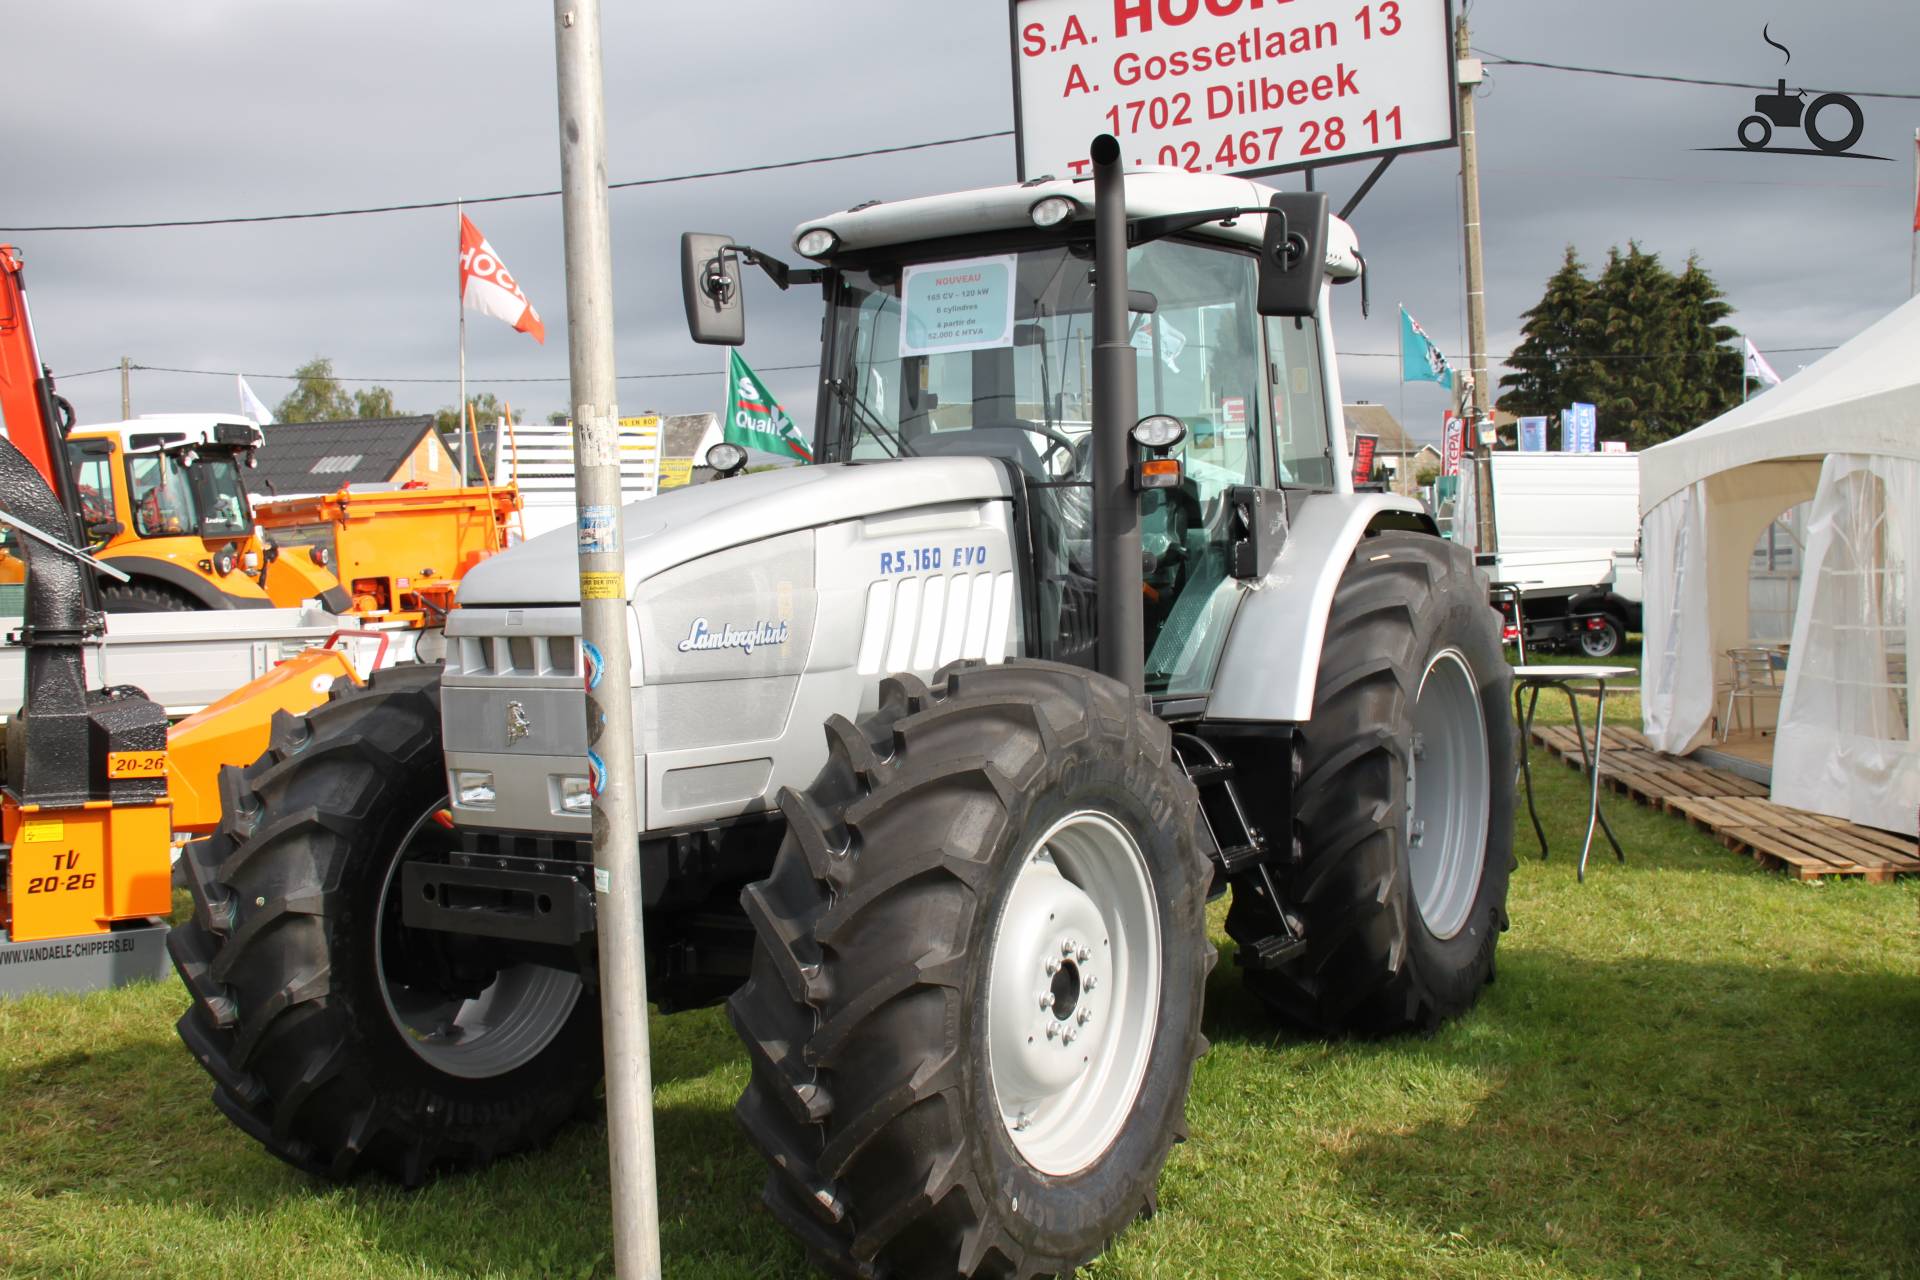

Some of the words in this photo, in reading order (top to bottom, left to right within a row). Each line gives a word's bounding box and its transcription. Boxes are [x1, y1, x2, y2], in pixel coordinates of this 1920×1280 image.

[1022, 14, 1098, 57] S.A.
[1063, 64, 1099, 97] A.
[1113, 20, 1337, 86] Gossetlaan
[1354, 1, 1402, 40] 13
[1105, 92, 1193, 137] 1702
[1206, 63, 1360, 120] Dilbeek
[1298, 116, 1346, 156] 28
[1362, 105, 1402, 144] 11
[935, 273, 981, 286] NOUVEAU
[942, 292, 954, 300] CV
[943, 304, 978, 314] cylindres
[943, 319, 965, 329] partir
[961, 328, 983, 336] HTVA
[953, 545, 987, 567] EVO
[678, 616, 789, 655] Lamborghini
[116, 758, 164, 771] 20-26
[53, 850, 80, 870] TV
[27, 873, 96, 894] 20-26
